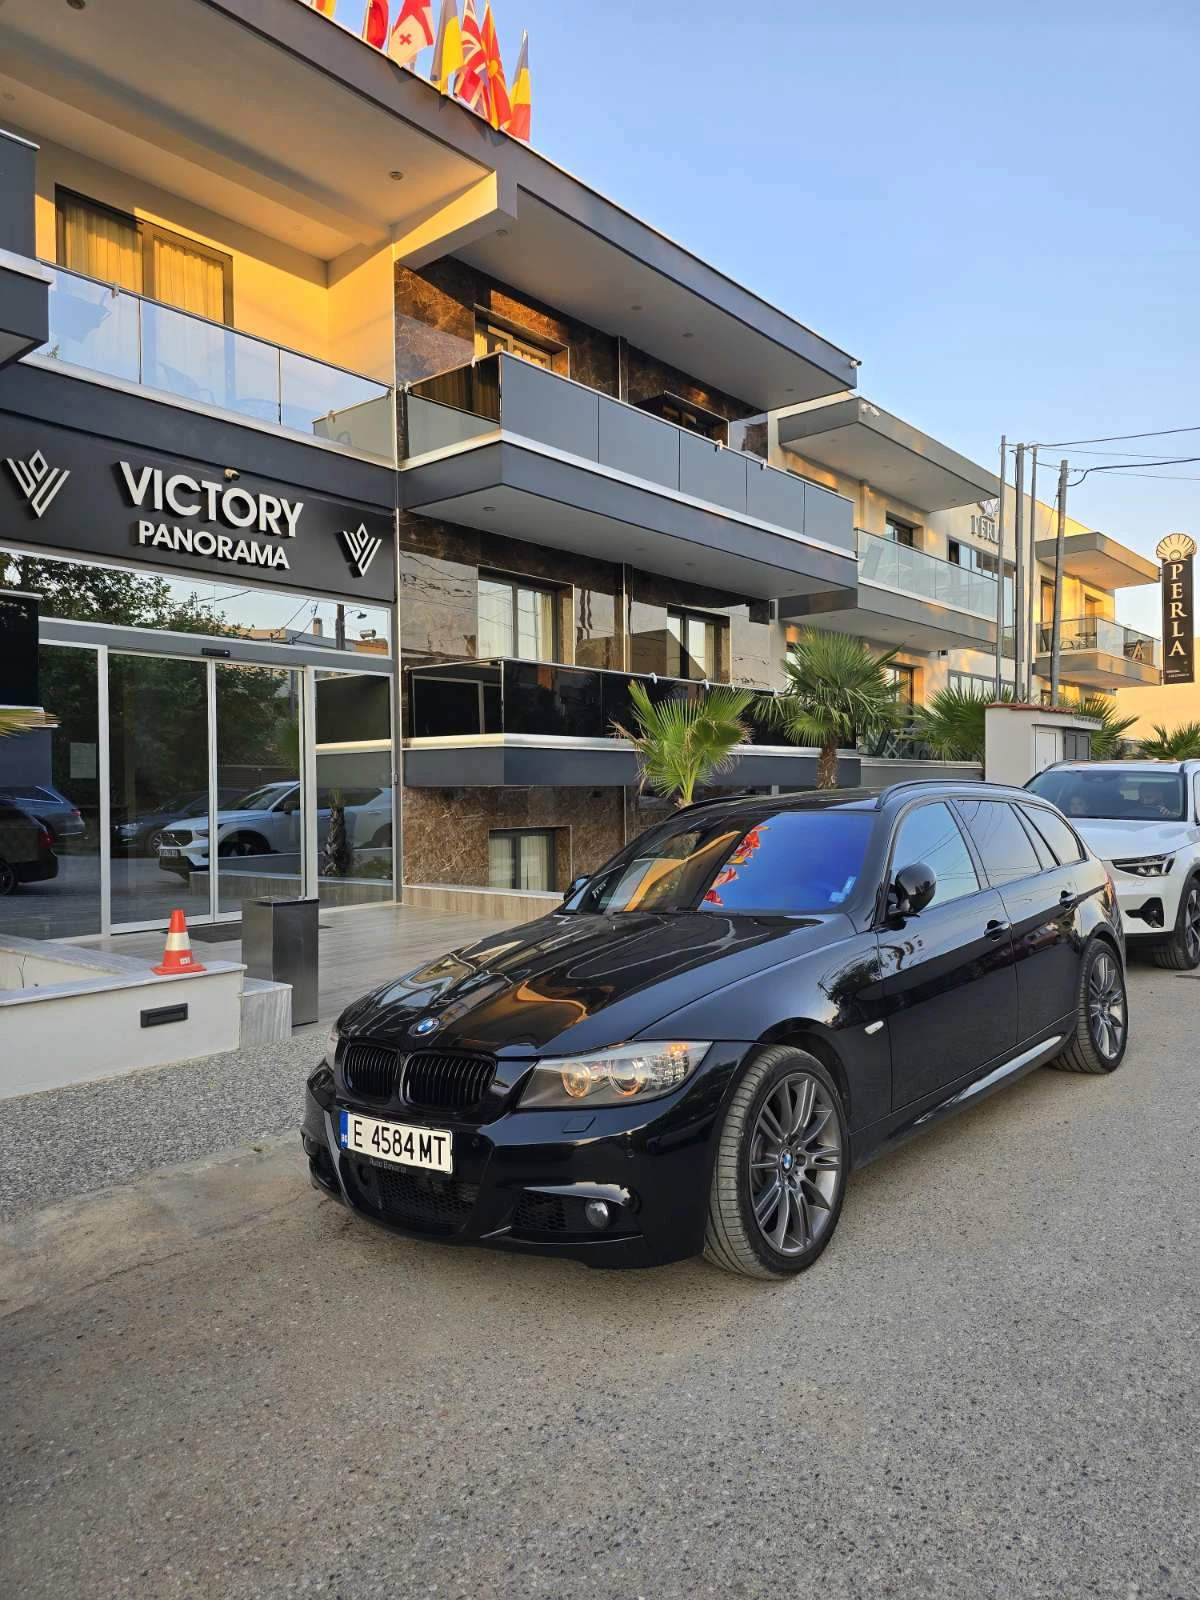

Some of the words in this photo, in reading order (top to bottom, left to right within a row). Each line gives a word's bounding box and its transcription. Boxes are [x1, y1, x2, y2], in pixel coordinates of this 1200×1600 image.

[119, 461, 304, 538] VICTORY
[138, 520, 291, 570] PANORAMA
[1168, 563, 1188, 657] PERLA
[354, 1119, 363, 1148] E
